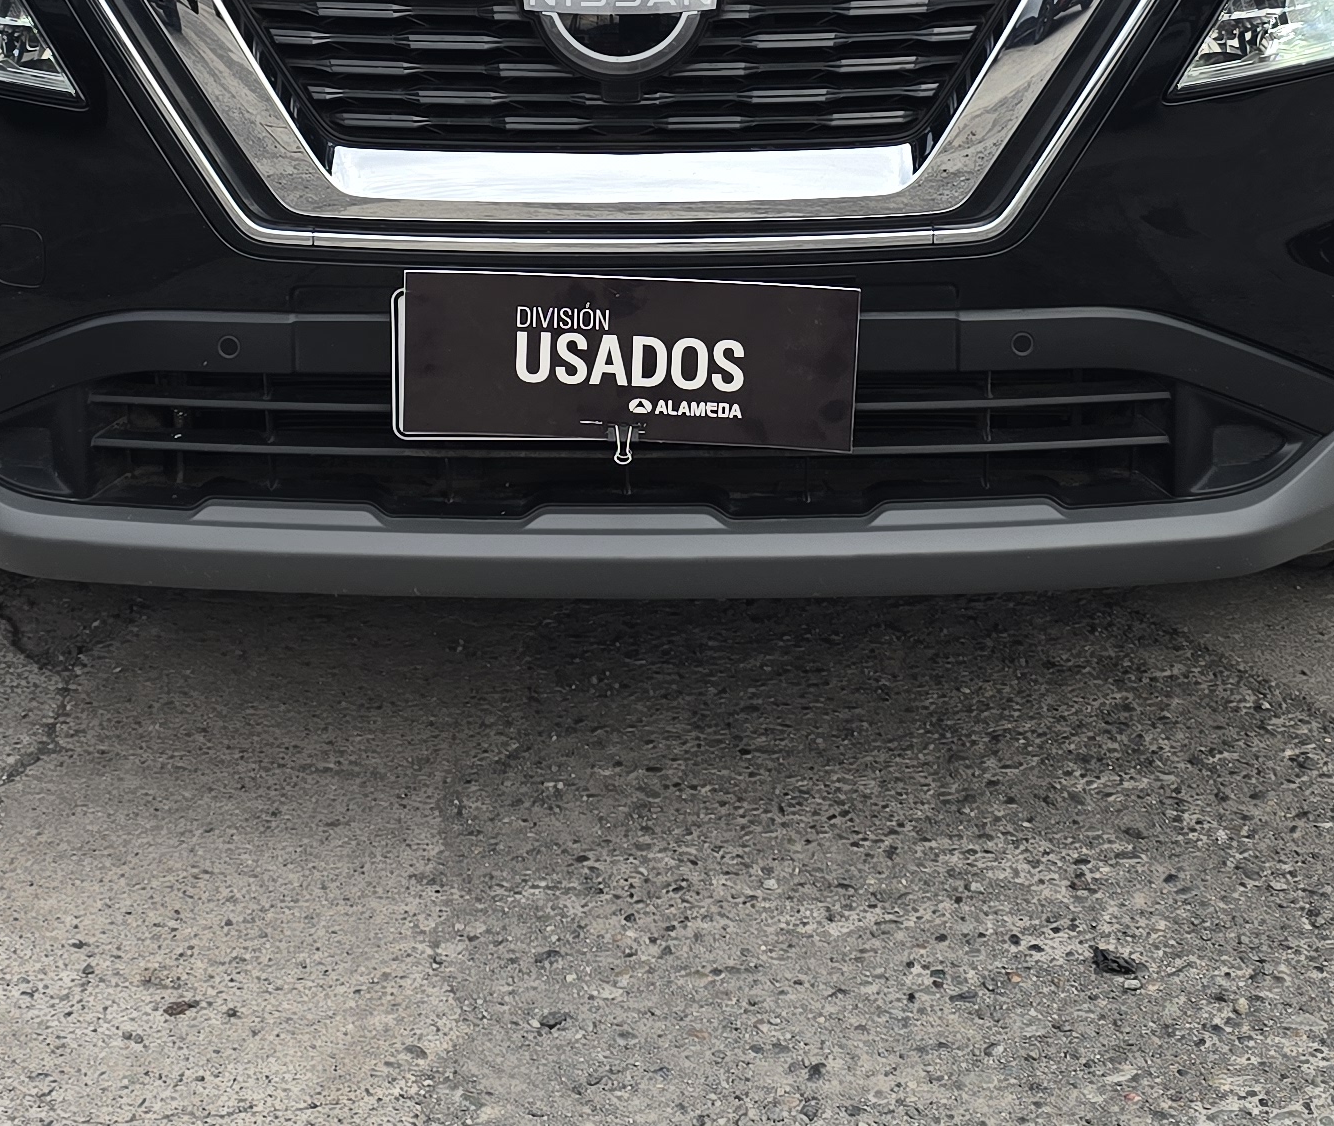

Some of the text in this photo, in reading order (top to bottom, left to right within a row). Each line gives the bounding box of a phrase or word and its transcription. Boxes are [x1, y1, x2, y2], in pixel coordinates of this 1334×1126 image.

[516, 302, 610, 331] DIVISIÓN
[515, 330, 745, 393] USADOS
[654, 399, 743, 419] ALAMEDA
